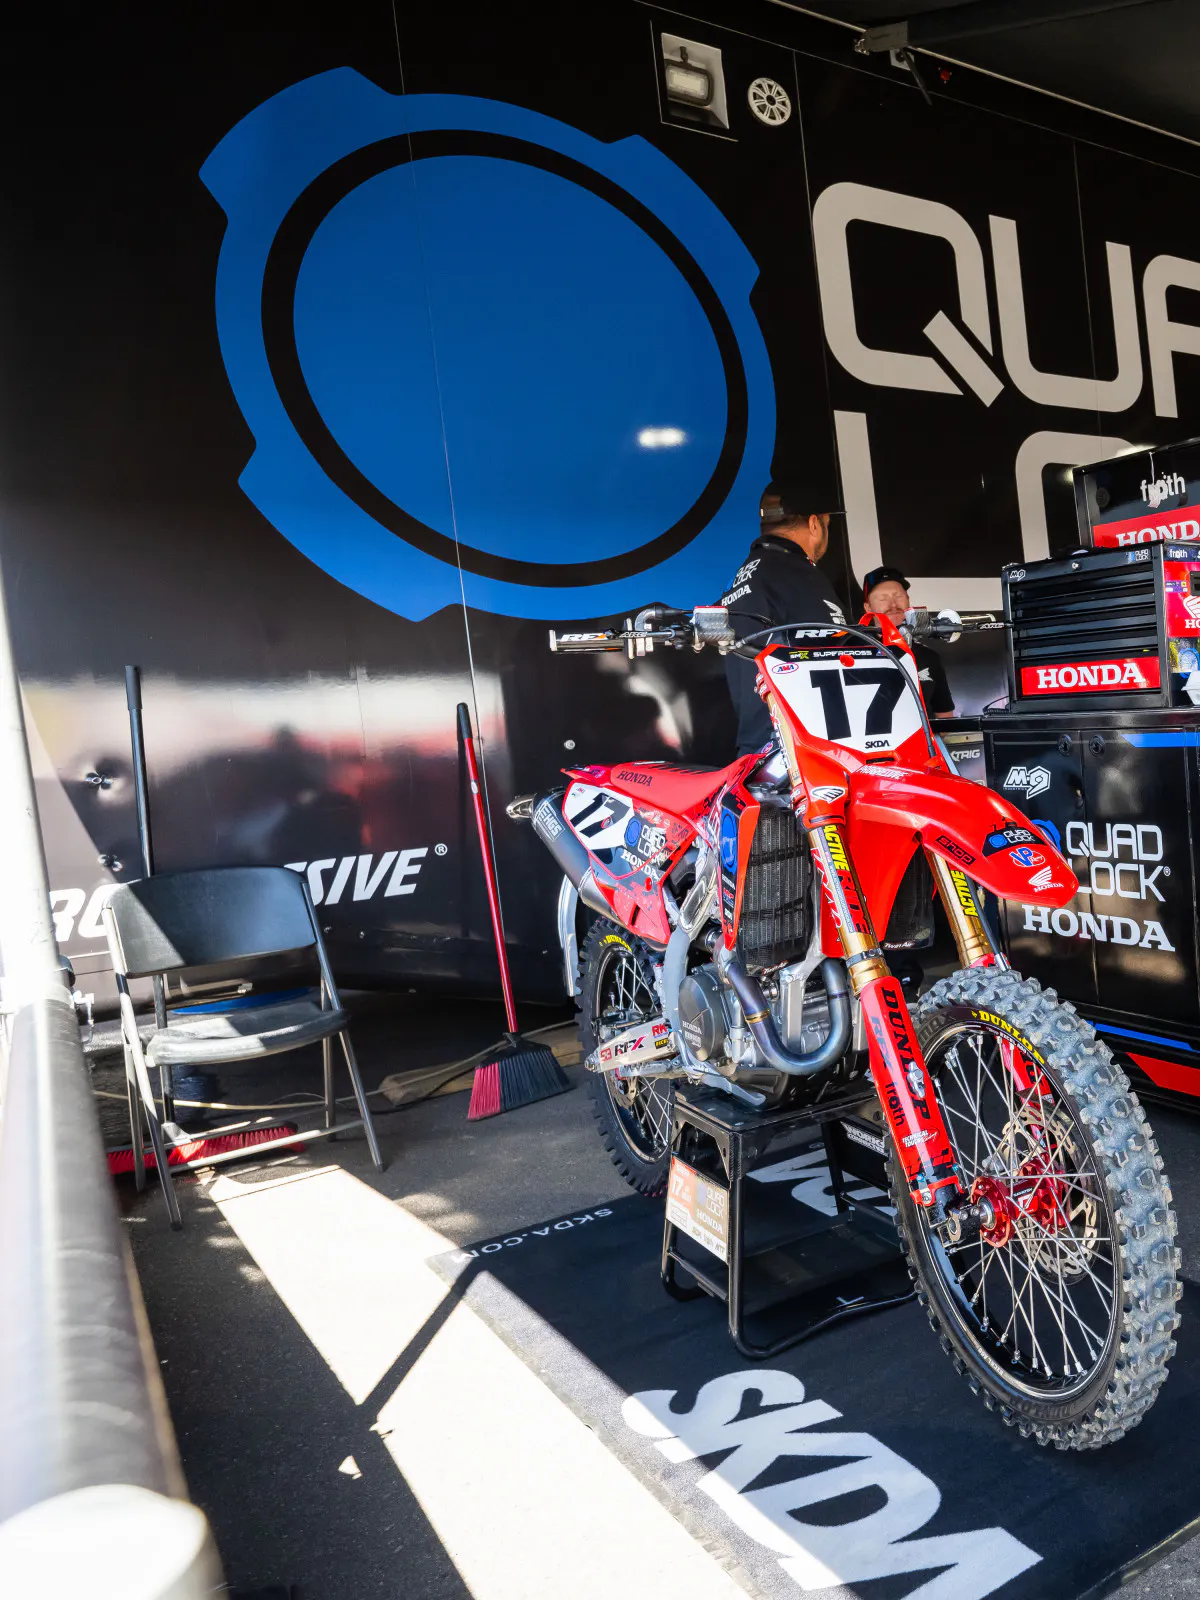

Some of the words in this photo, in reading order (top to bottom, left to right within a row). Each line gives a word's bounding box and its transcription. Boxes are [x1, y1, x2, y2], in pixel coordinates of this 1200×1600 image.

[721, 584, 752, 606] HONDA
[812, 650, 872, 658] SUPERCROSS
[1037, 661, 1147, 691] HONDA
[809, 667, 908, 741] 17
[864, 739, 890, 750] SKDA
[616, 770, 653, 787] HONDA
[570, 792, 631, 838] 17
[822, 824, 850, 872] ACTIVE
[1003, 829, 1032, 839] QUAD
[1066, 821, 1164, 861] QUAD
[620, 849, 660, 881] HONDA
[1009, 846, 1034, 868] VP
[949, 869, 979, 918] ACTIVE
[1034, 882, 1065, 893] HONDA
[1021, 903, 1176, 952] HONDA
[682, 1020, 703, 1035] HONDA
[979, 1010, 1046, 1065] DUNLOP
[884, 1081, 905, 1127] froth
[696, 1208, 724, 1234] HONDA
